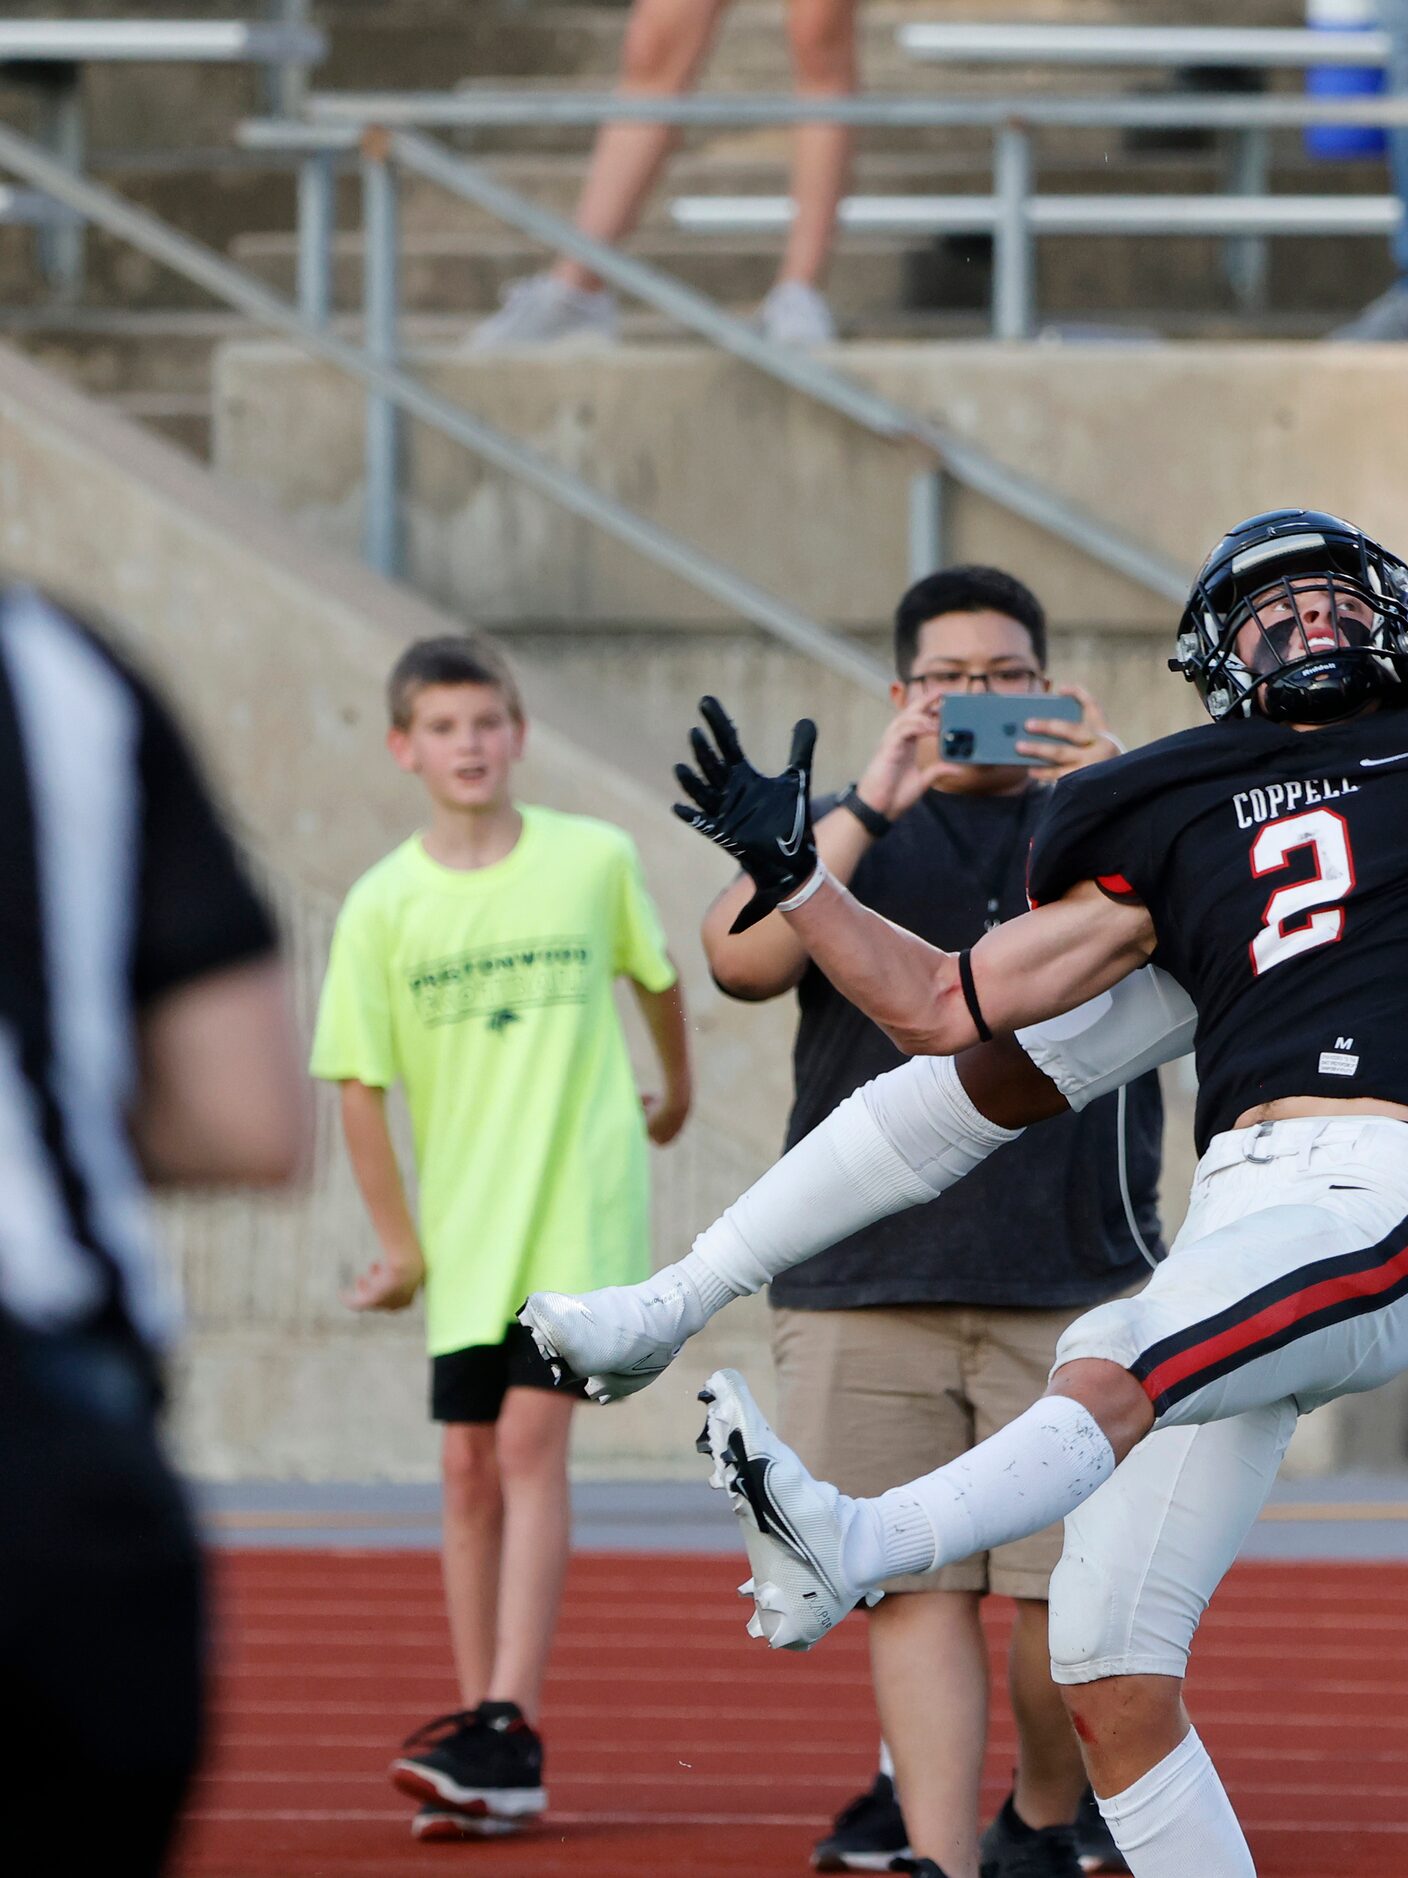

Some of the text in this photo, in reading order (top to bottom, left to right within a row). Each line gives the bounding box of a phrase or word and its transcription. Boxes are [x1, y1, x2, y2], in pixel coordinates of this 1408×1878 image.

[1232, 777, 1361, 829] COPPELL
[1250, 806, 1357, 978] 2
[1333, 1036, 1354, 1050] M
